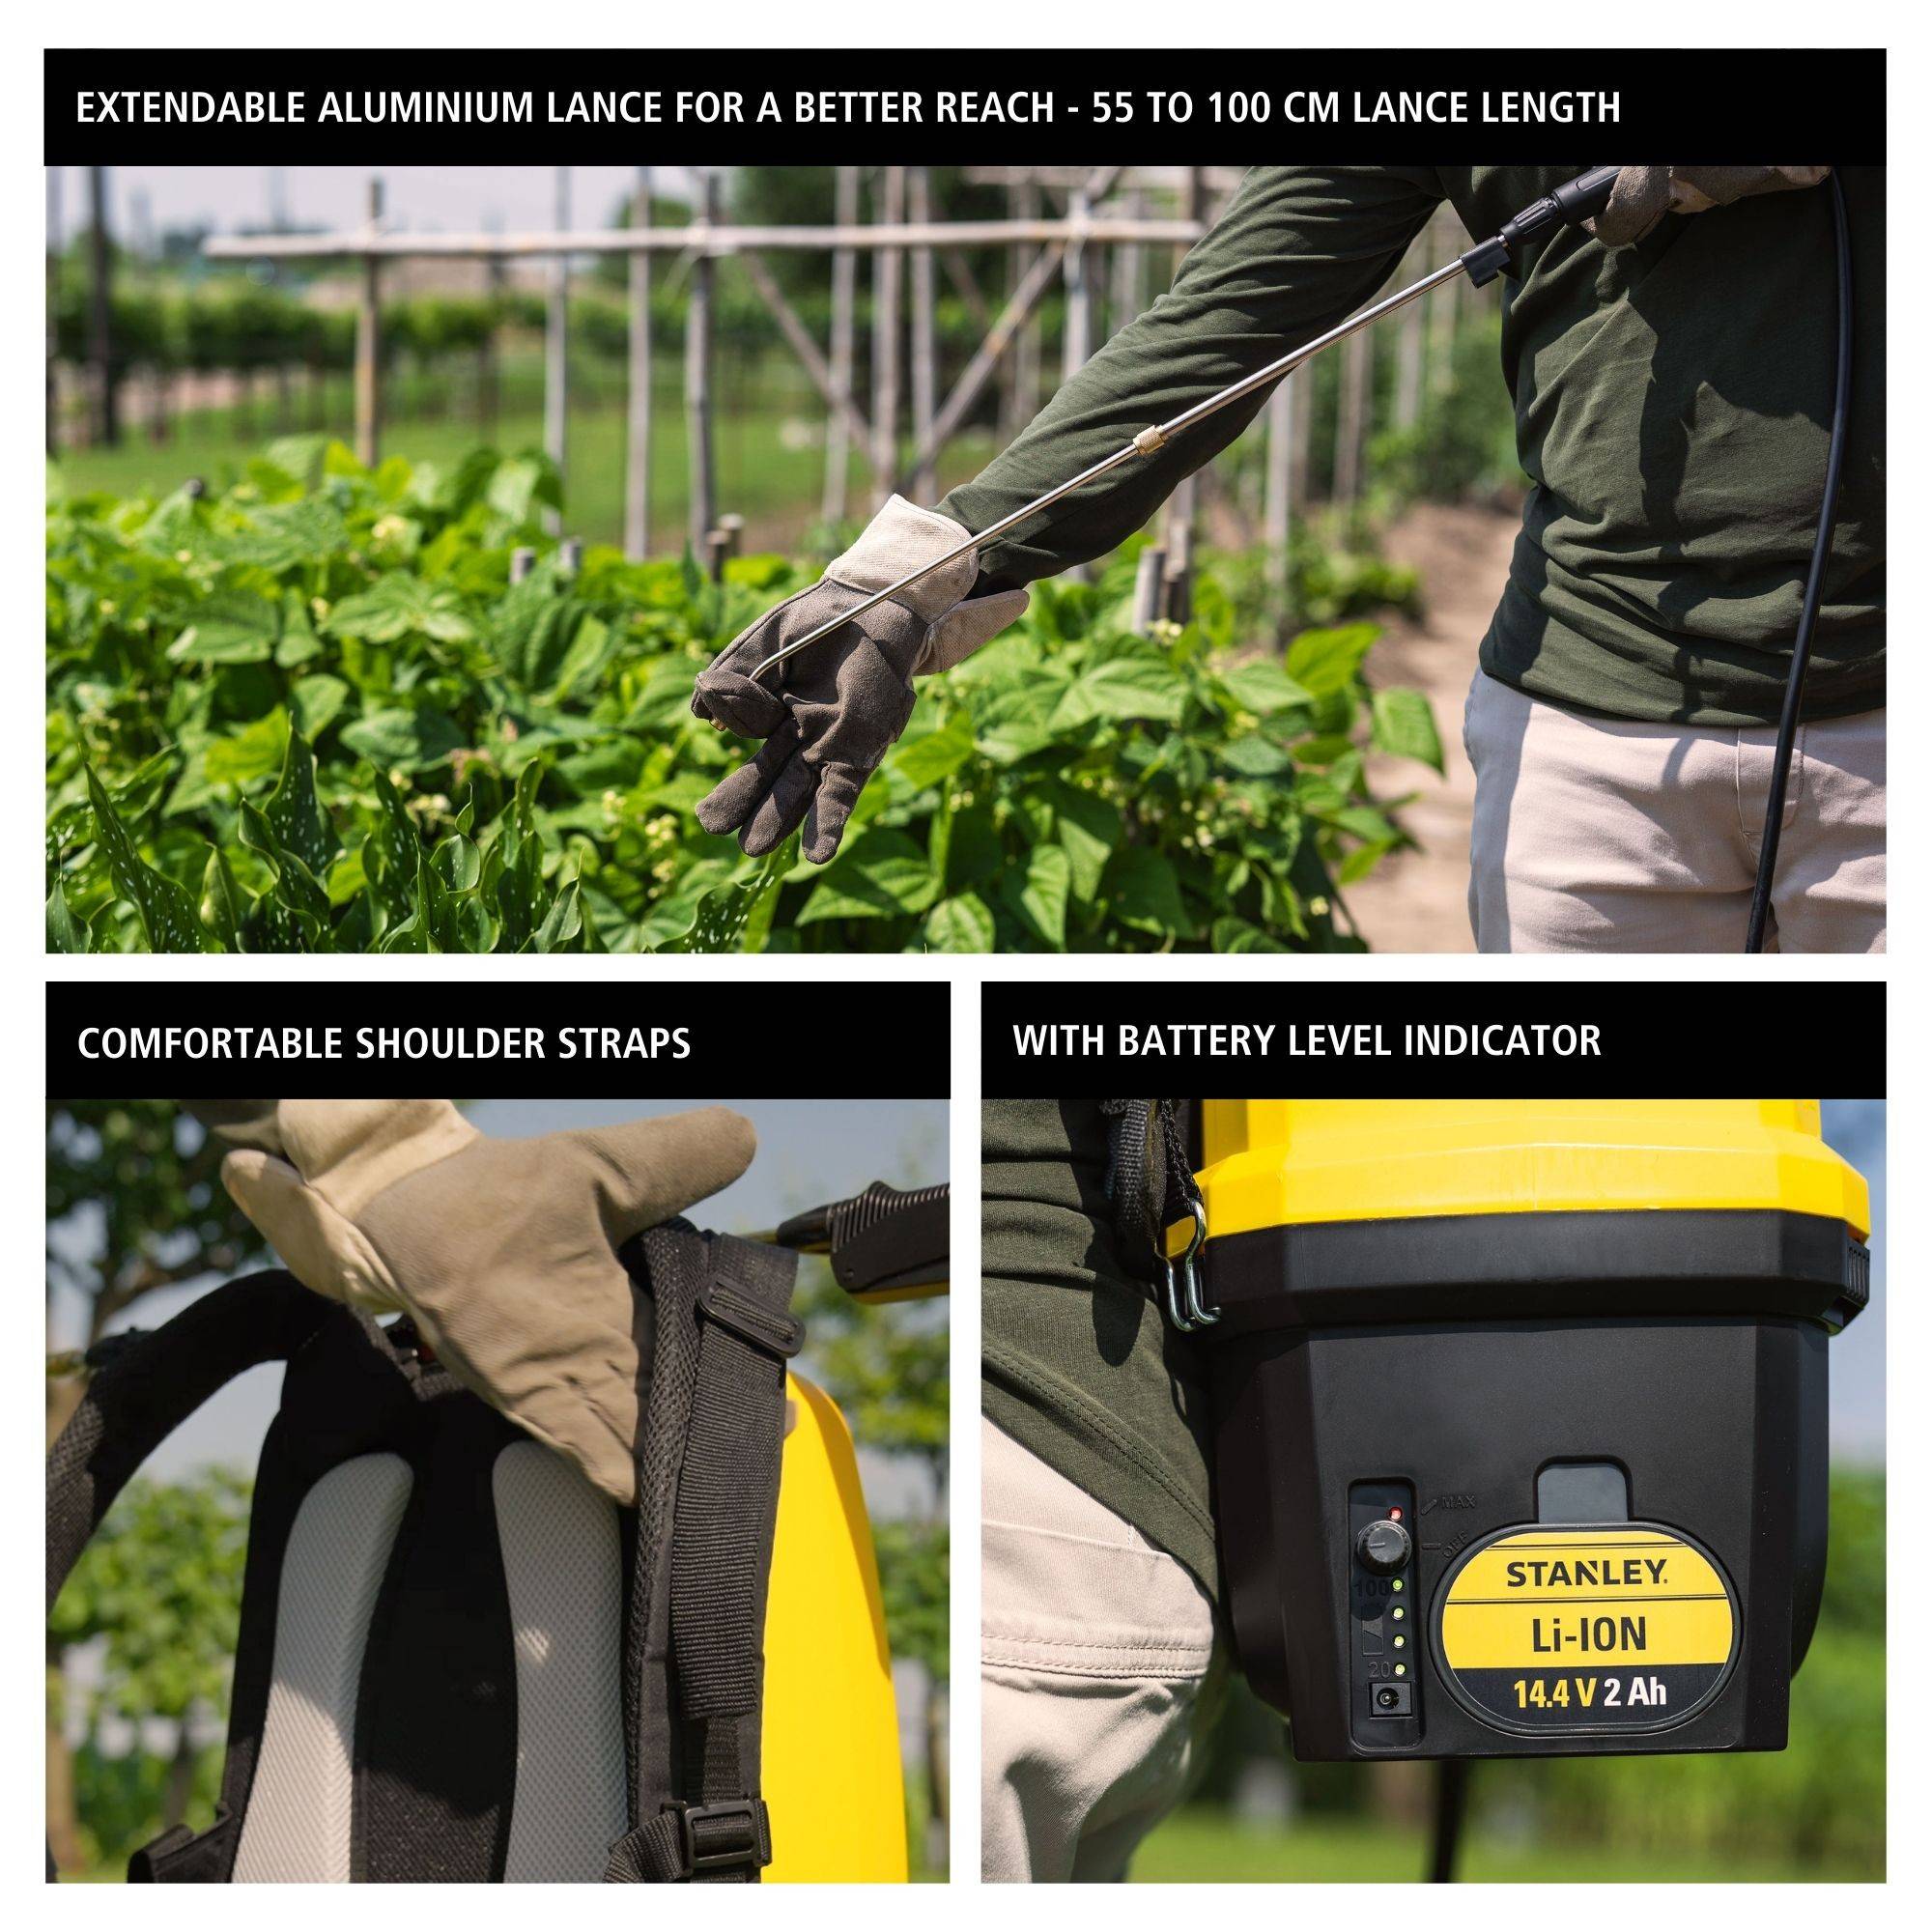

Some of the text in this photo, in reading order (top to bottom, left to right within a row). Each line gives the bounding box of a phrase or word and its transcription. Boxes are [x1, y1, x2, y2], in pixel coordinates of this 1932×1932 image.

[1441, 1494, 1476, 1509] MAX
[1441, 1530, 1468, 1559] OFF
[1353, 1577, 1390, 1597] 100
[1506, 1558, 1667, 1587] STANLEY
[1532, 1616, 1647, 1652] Li-ION
[1367, 1661, 1390, 1678] 20
[1514, 1676, 1667, 1709] 14.4 V 2 Ah
